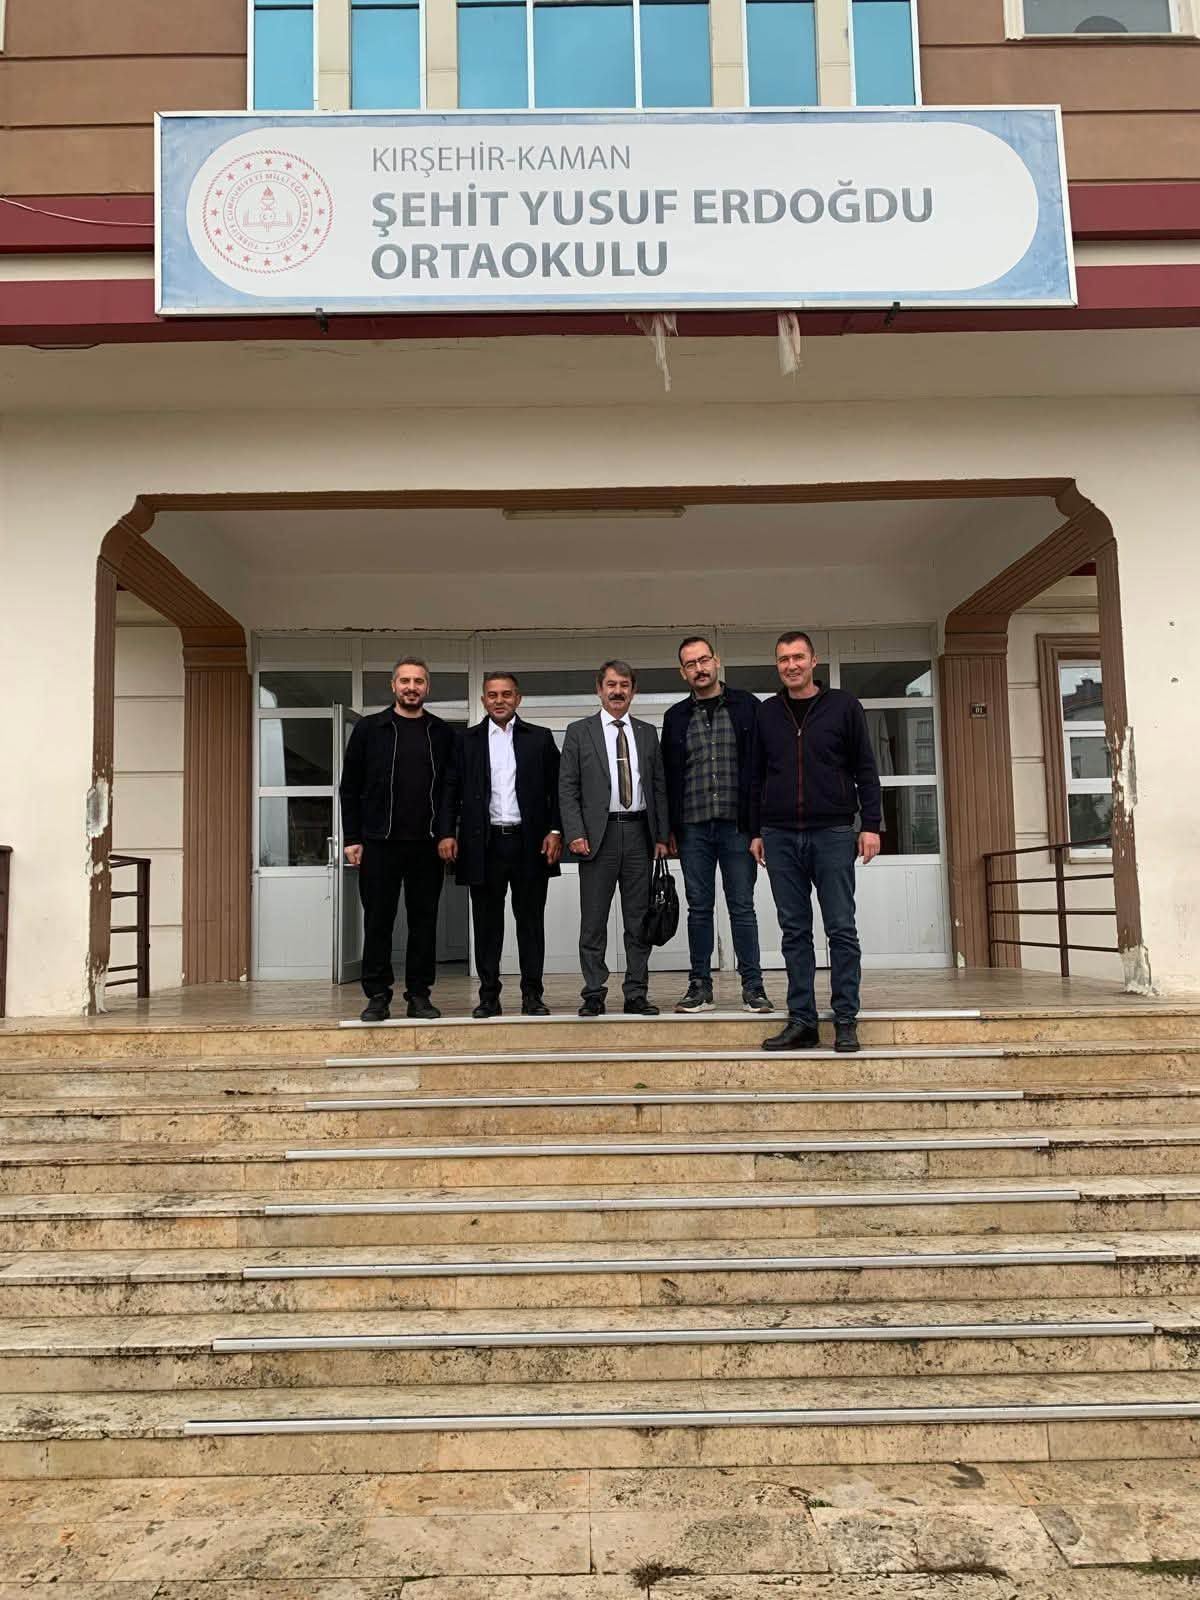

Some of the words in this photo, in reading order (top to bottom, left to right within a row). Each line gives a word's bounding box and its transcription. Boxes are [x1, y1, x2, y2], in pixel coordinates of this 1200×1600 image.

[372, 142, 631, 178] KIRŞEHİR-KAMAN
[371, 182, 509, 237] ŞEHİT
[519, 189, 678, 226] YUSUF
[693, 179, 933, 225] ERDOĞDU
[371, 240, 668, 279] ORTAOKULU
